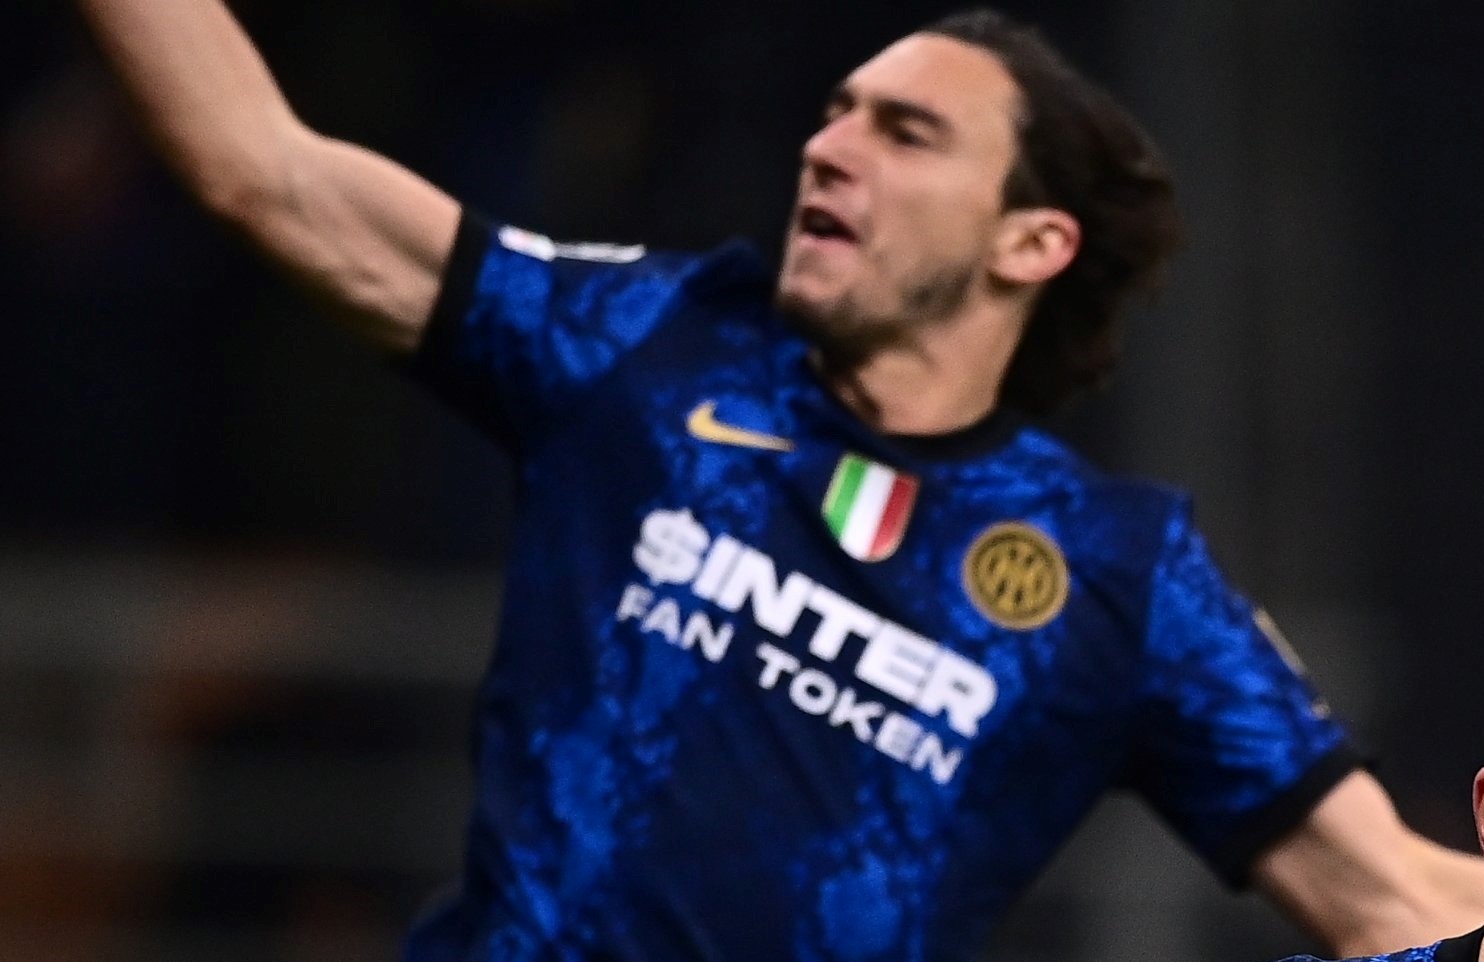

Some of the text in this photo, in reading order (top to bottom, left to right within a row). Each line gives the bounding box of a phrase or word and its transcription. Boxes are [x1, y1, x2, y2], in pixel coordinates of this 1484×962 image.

[616, 583, 963, 785] FAN TOKEN
[631, 507, 998, 738] $INTER
